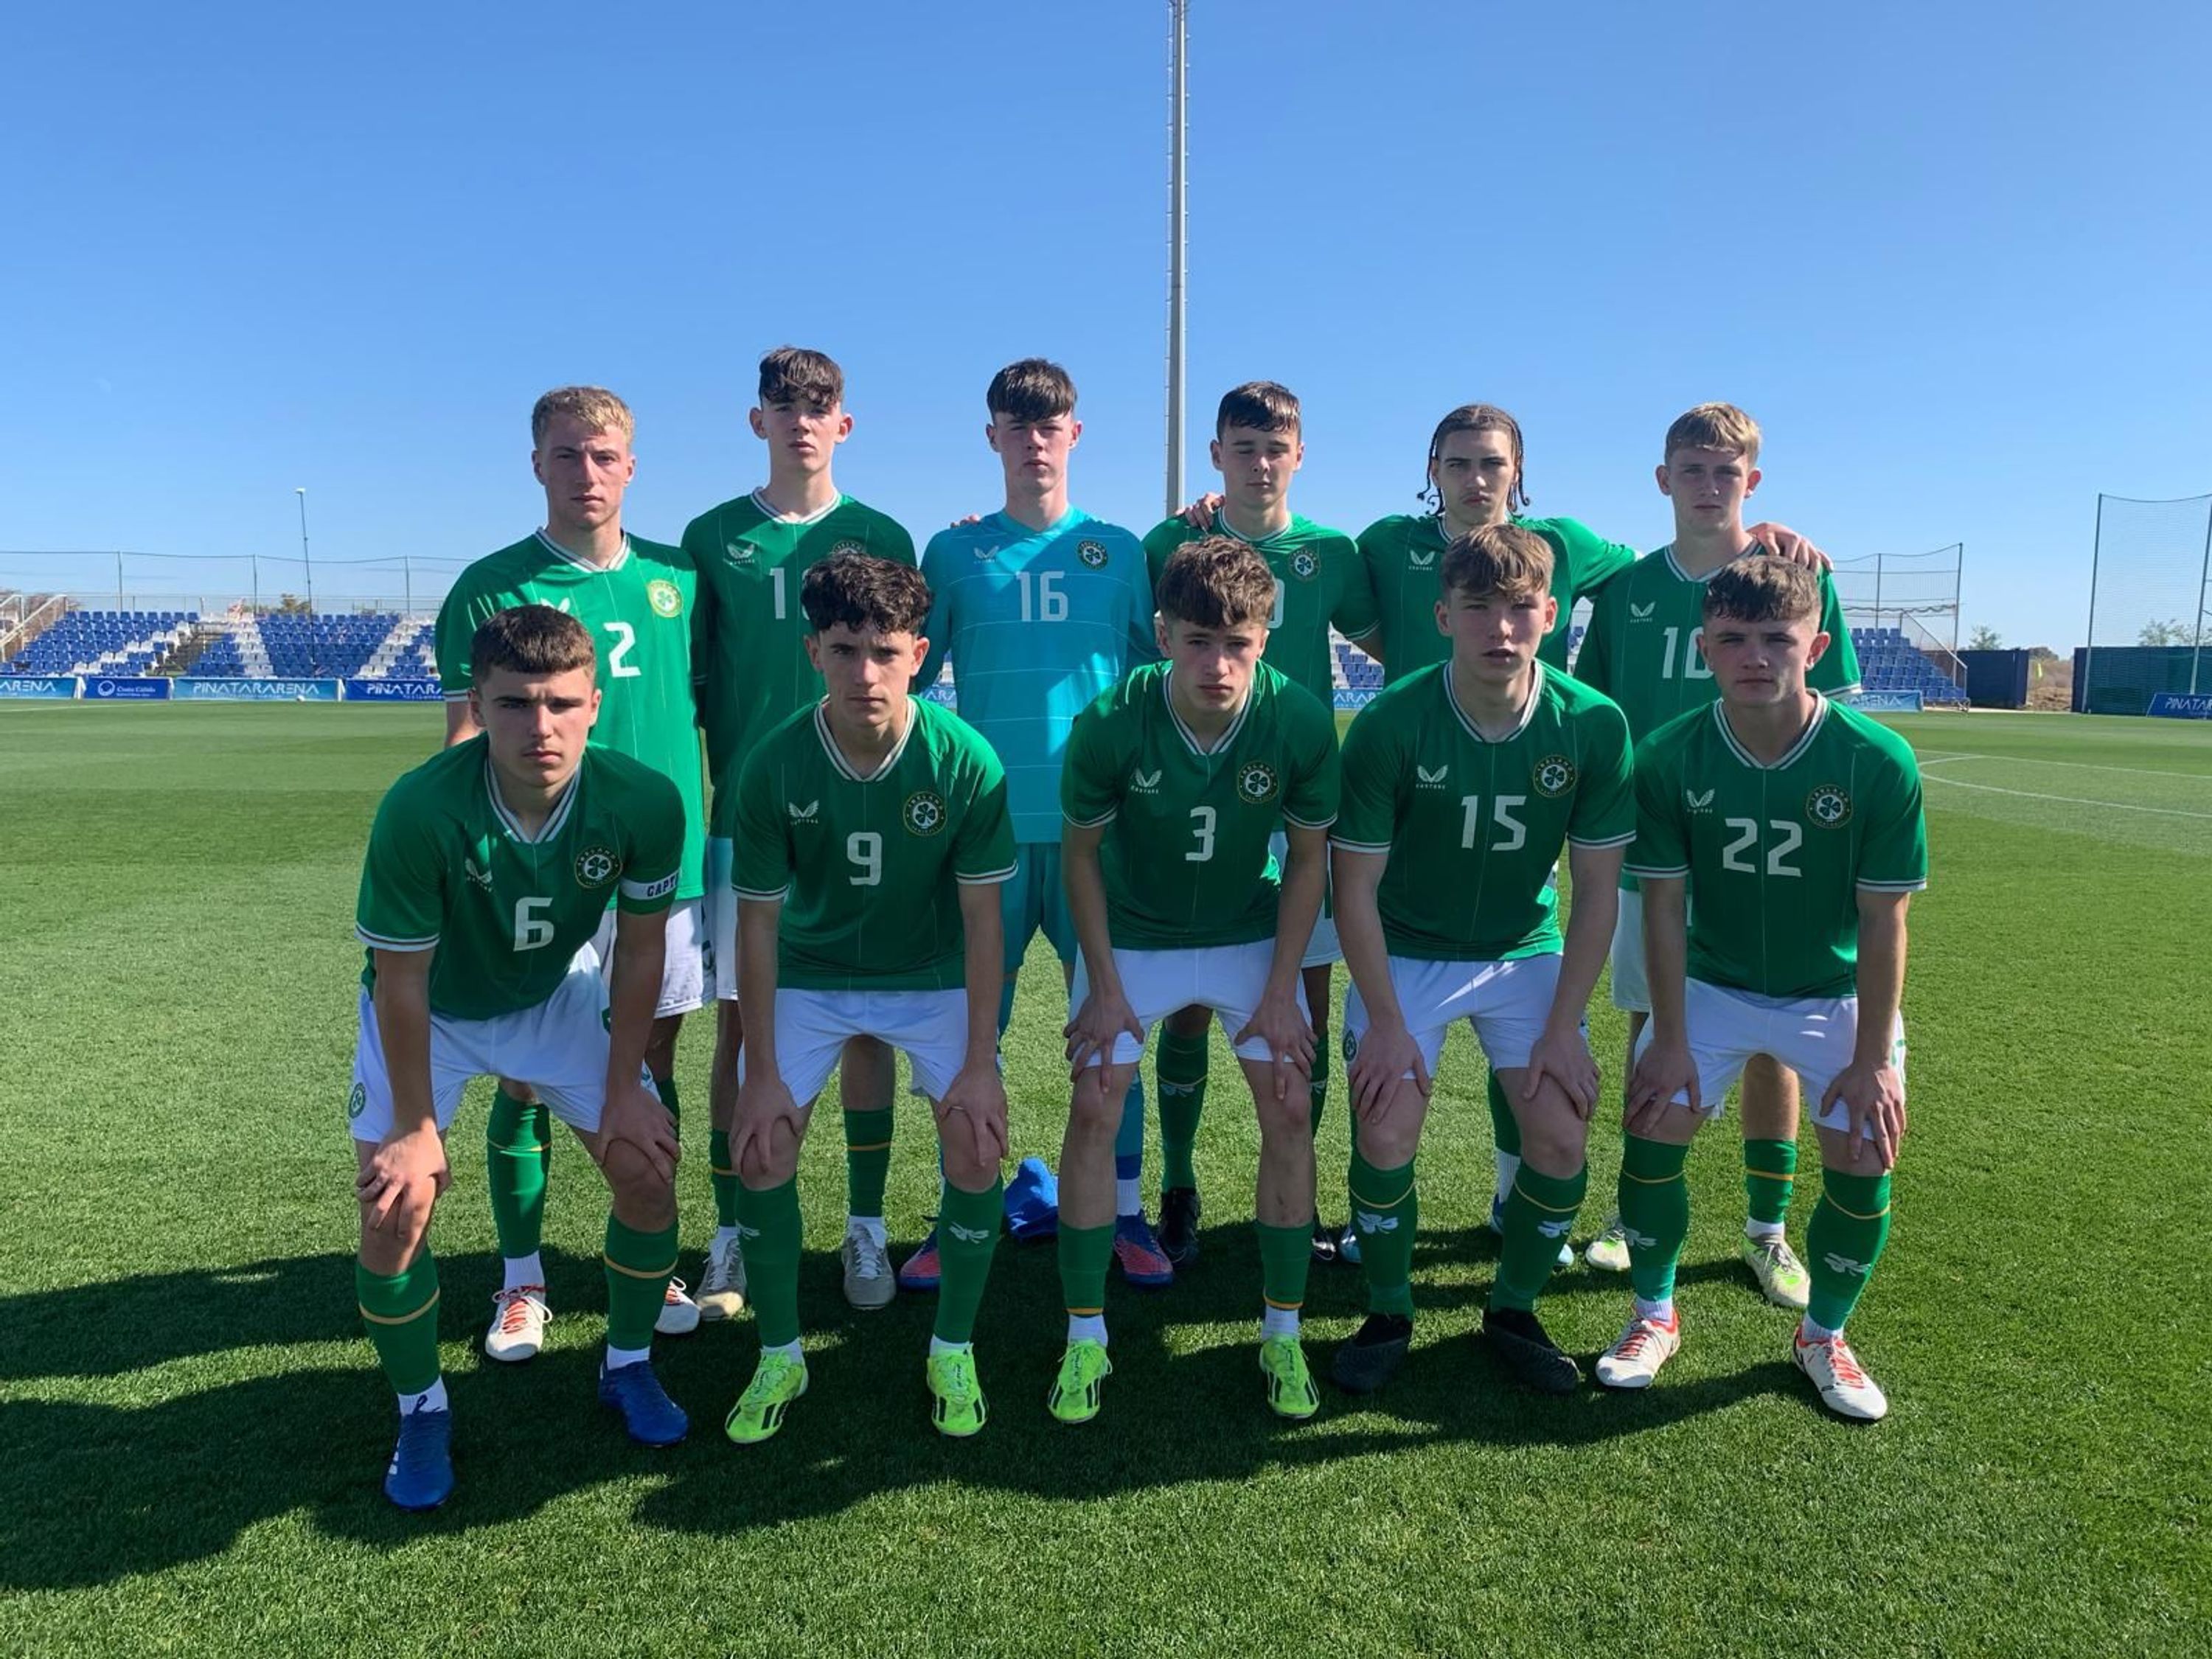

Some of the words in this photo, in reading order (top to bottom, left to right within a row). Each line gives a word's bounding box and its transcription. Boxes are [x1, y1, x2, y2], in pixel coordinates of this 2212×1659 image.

[1016, 571, 1068, 622] 16
[603, 622, 641, 677] 2
[1185, 806, 1217, 861] 3
[1461, 795, 1527, 851] 15
[1722, 818, 1804, 877] 22
[847, 832, 882, 886] 9
[513, 896, 554, 952] 6
